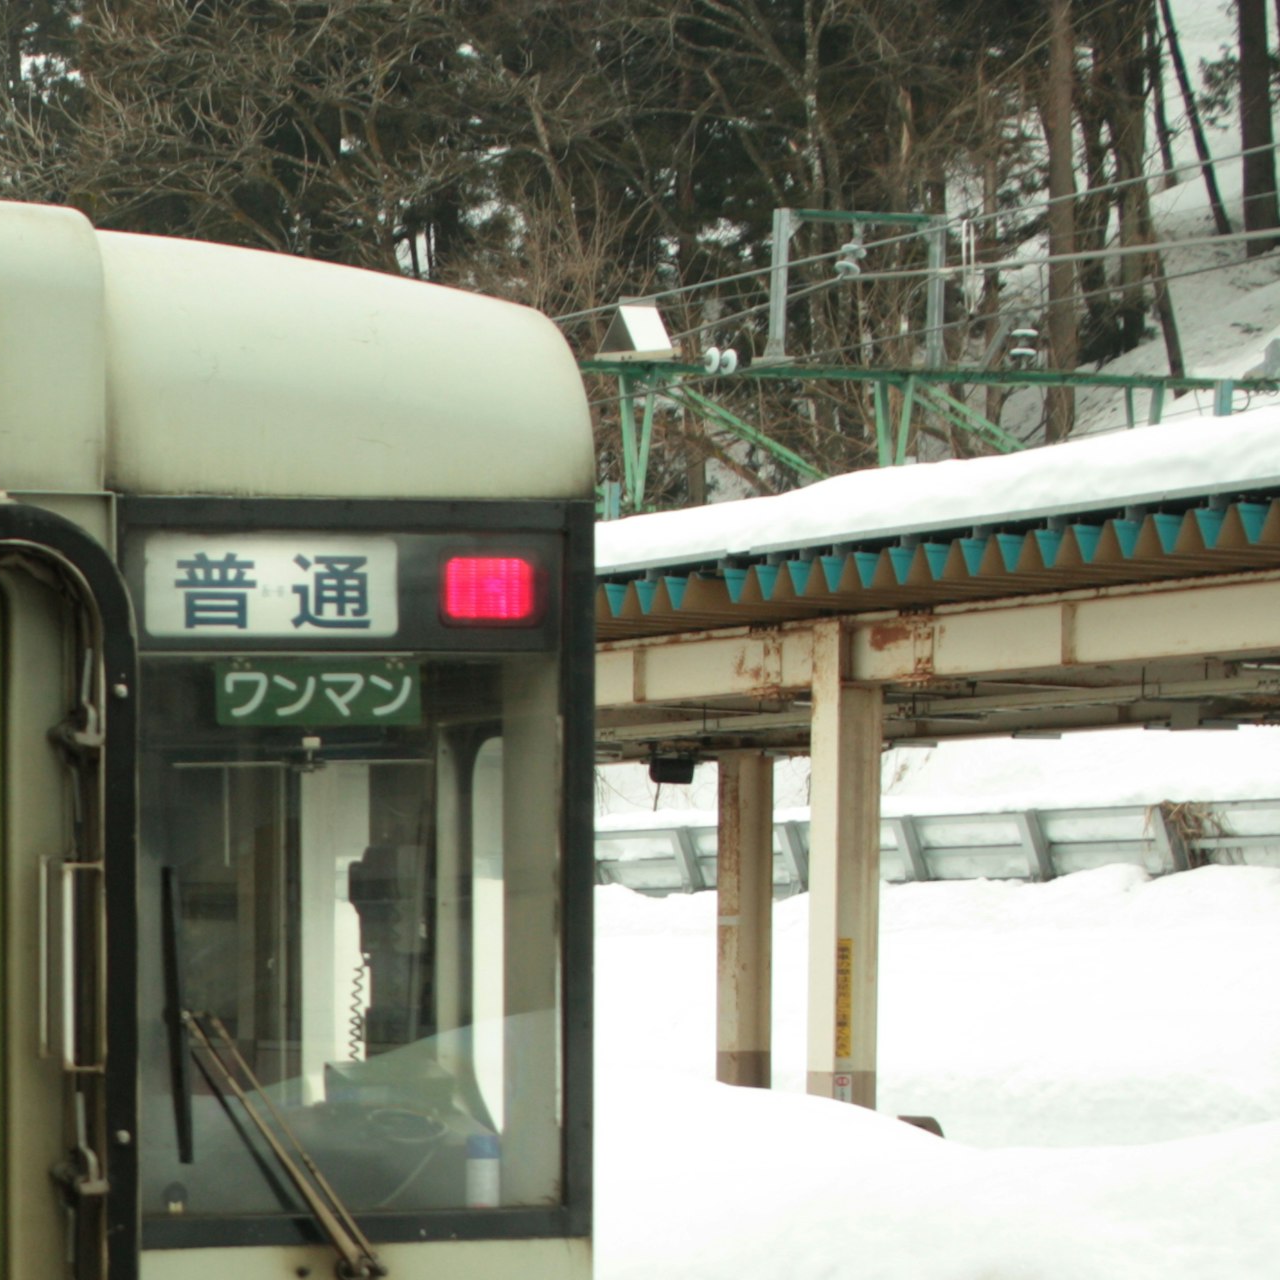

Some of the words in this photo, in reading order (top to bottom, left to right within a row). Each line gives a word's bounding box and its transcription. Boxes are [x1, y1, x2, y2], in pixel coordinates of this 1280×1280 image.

[175, 552, 372, 630] 普通
[224, 671, 413, 718] ワンマン
